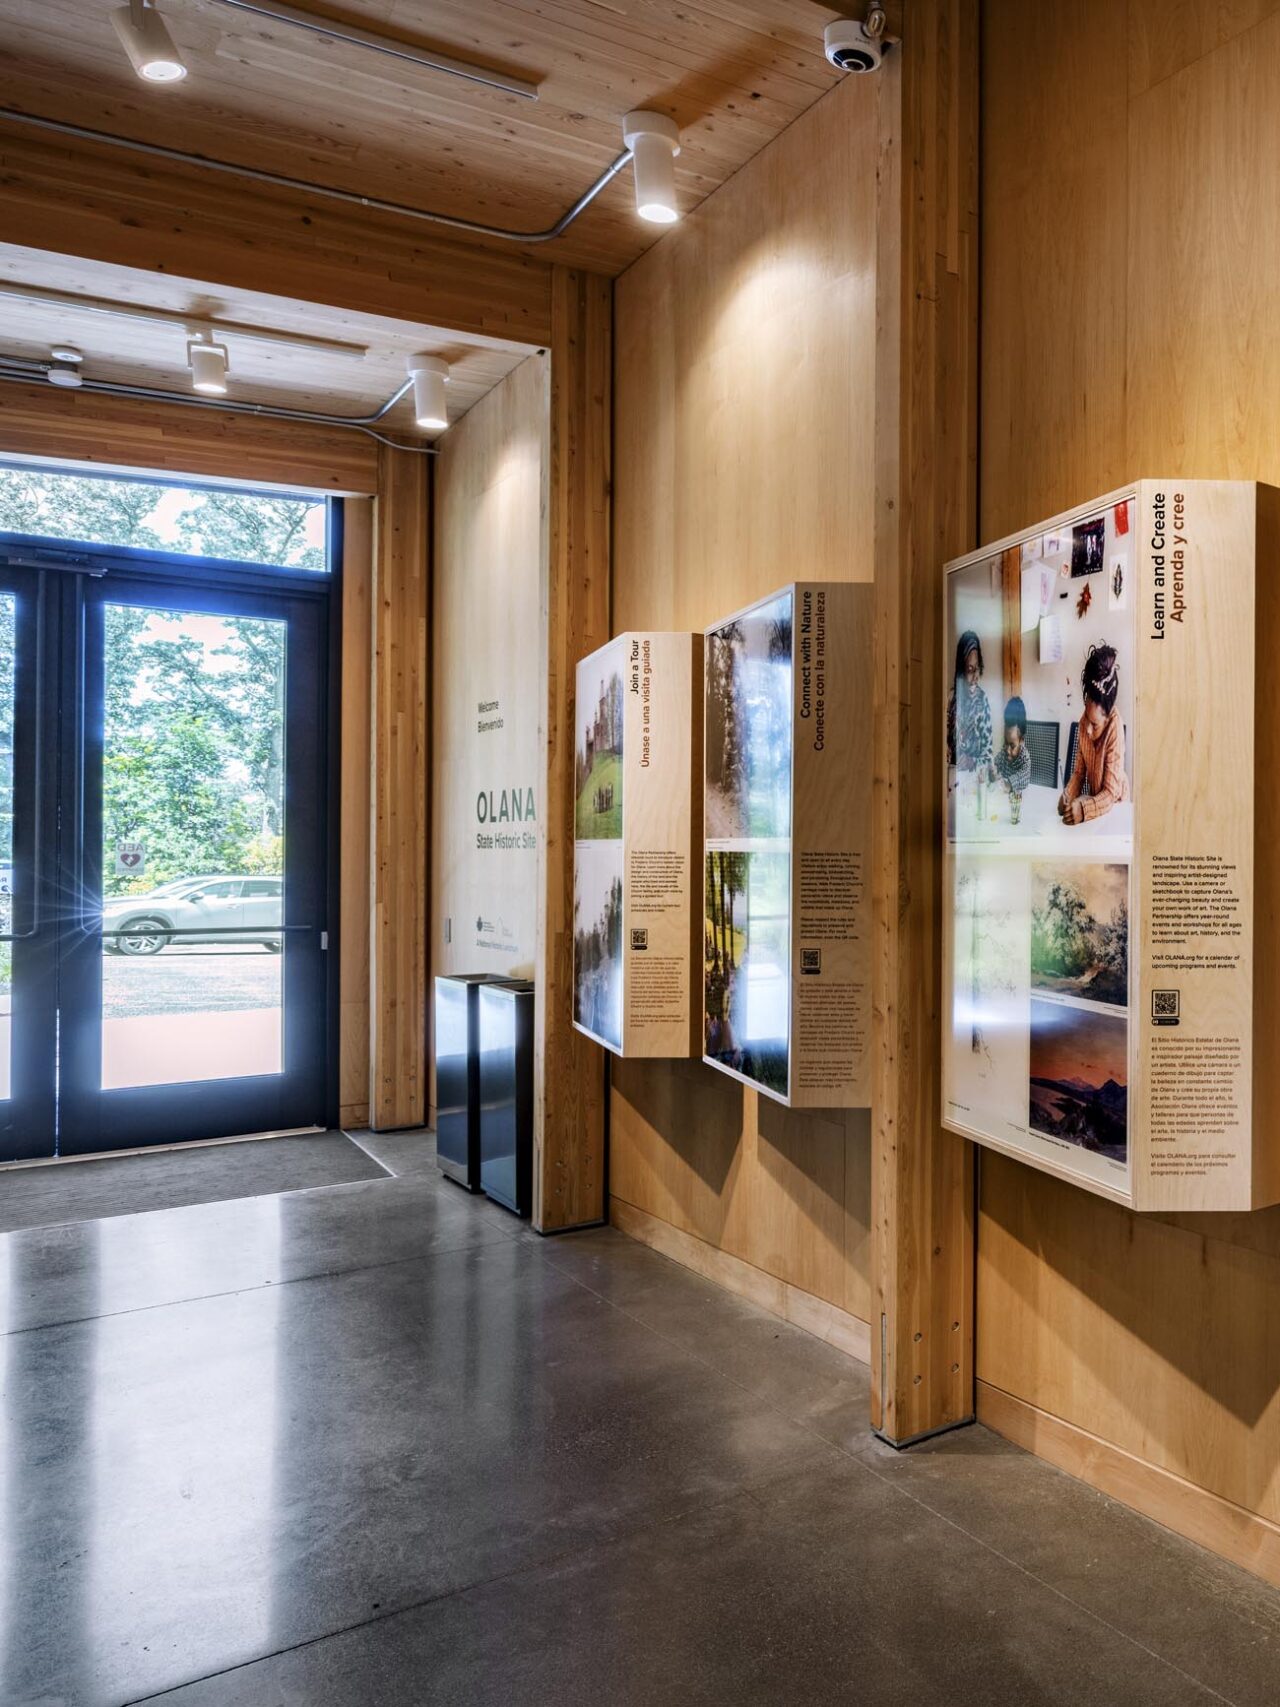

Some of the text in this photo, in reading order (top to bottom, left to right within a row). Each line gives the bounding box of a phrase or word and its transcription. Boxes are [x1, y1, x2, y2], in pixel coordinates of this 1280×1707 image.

[1151, 493, 1165, 639] Learn and Create
[1170, 493, 1187, 623] Aprenda y cree
[630, 640, 639, 662] Tour
[641, 640, 652, 673] guiada
[800, 591, 812, 718] Connect with Nature
[630, 672, 639, 694] Join
[814, 592, 826, 751] Conecte con la naturaleza
[641, 677, 650, 703] visita
[478, 700, 499, 713] Welcome
[477, 719, 504, 733] Bienvenido
[639, 736, 650, 767] Únase
[476, 786, 536, 824] OLANA
[476, 831, 536, 849] State Historic Site
[1191, 888, 1211, 896] capture
[1165, 954, 1195, 962] OLANA.org
